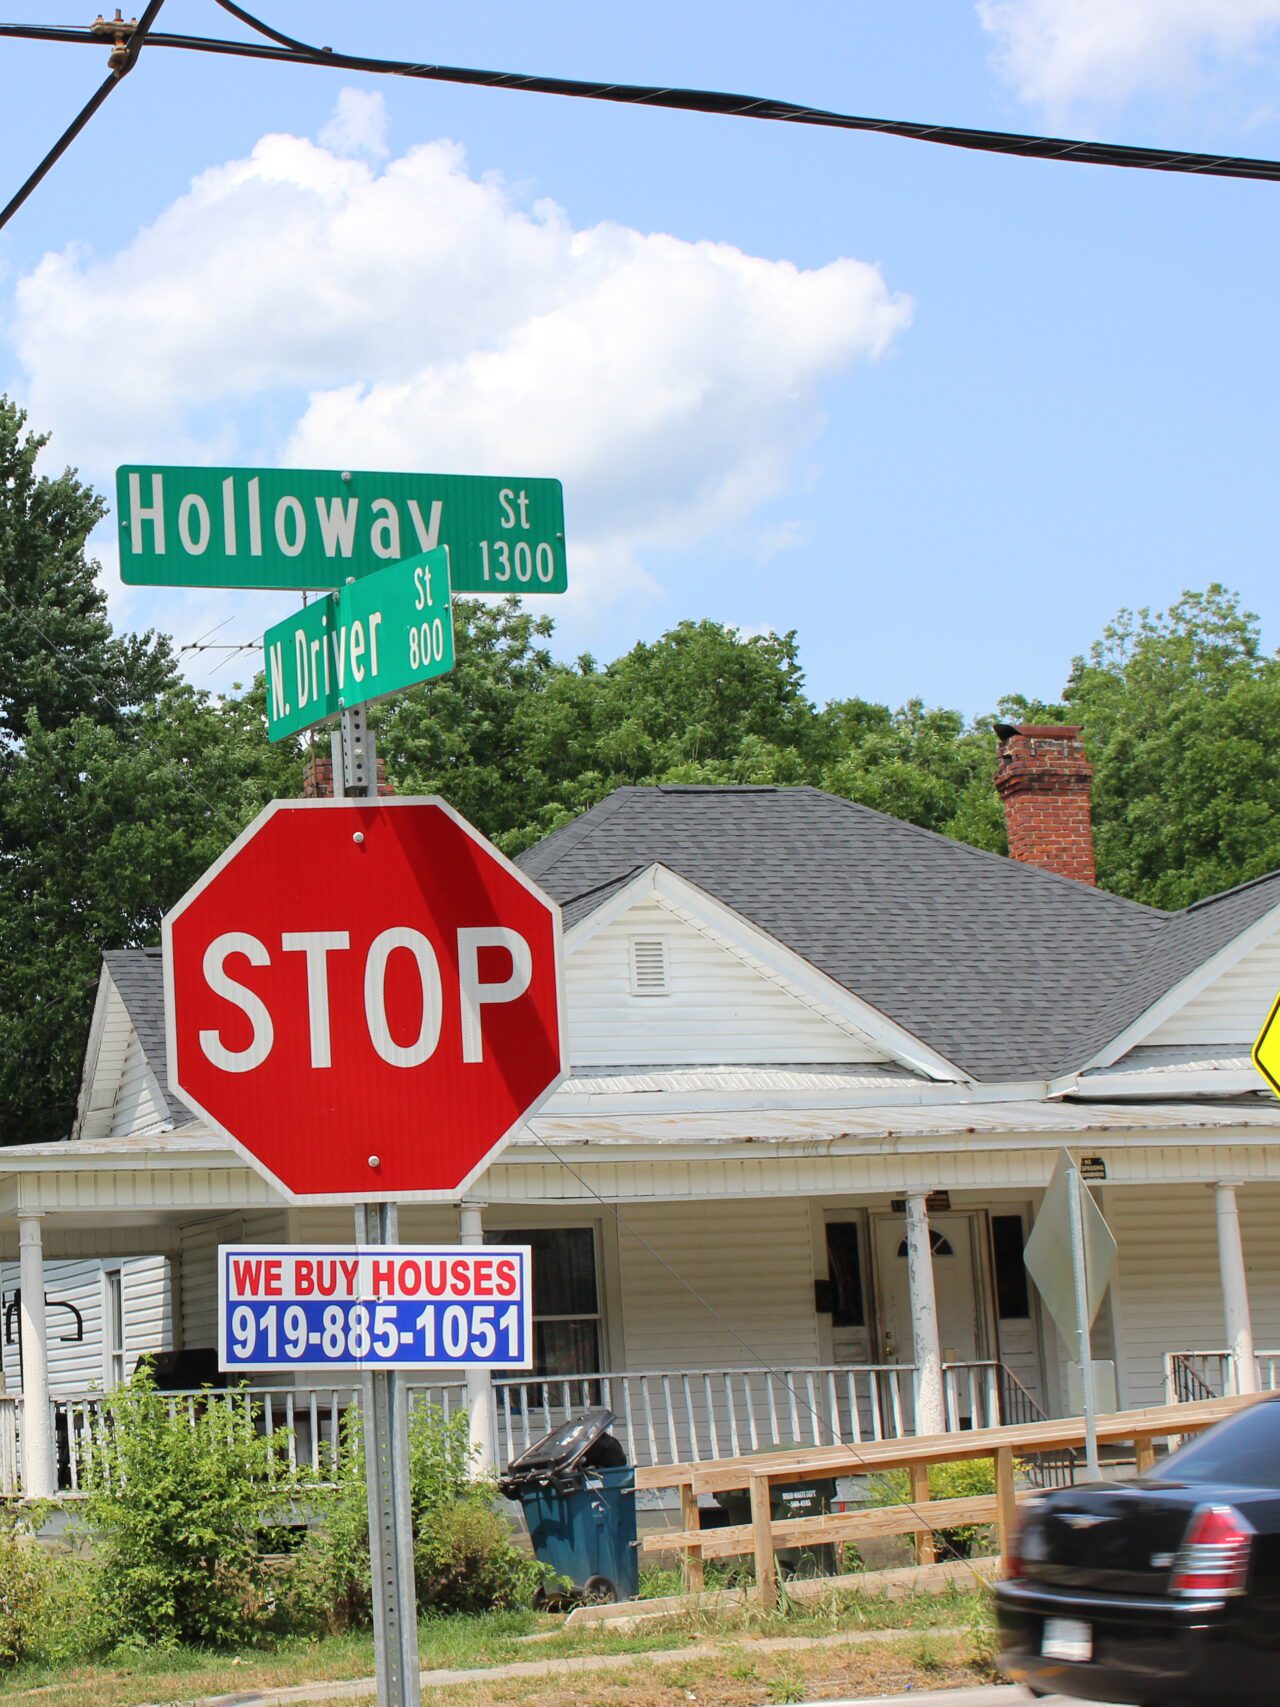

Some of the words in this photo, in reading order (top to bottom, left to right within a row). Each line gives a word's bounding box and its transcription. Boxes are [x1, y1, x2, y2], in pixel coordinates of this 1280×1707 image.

[128, 472, 443, 560] Holloway
[499, 488, 530, 530] St
[478, 540, 555, 583] 1300
[269, 642, 290, 722] N.
[295, 610, 383, 709] Driver
[413, 564, 433, 611] St
[408, 617, 444, 671] 800
[198, 926, 533, 1074] STOP
[232, 1259, 283, 1296] WE
[294, 1259, 359, 1296] BUY
[371, 1259, 517, 1297] HOUSES
[231, 1304, 519, 1359] 919-885-1051
